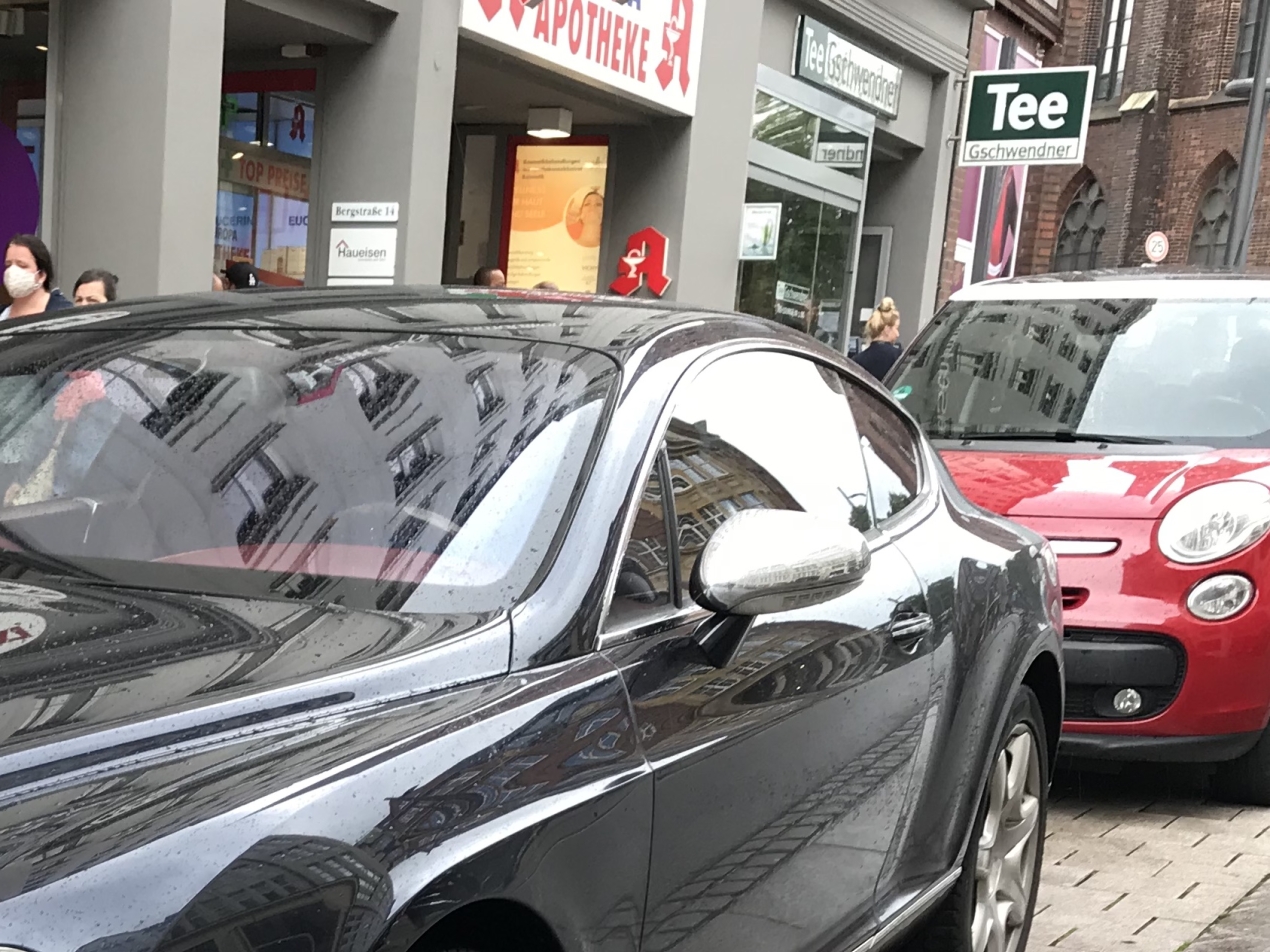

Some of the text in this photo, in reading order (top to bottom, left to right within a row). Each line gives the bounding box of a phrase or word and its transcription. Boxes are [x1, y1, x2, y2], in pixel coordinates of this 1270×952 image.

[533, 0, 650, 83] APOTHEKE
[805, 27, 899, 107] Tee Gschwendner
[987, 83, 1069, 131] Tee
[969, 142, 1072, 159] Gschwendner
[239, 160, 307, 195] TOP PREISE
[335, 206, 395, 217] Bergstraße 14
[337, 247, 387, 258] Haueisen
